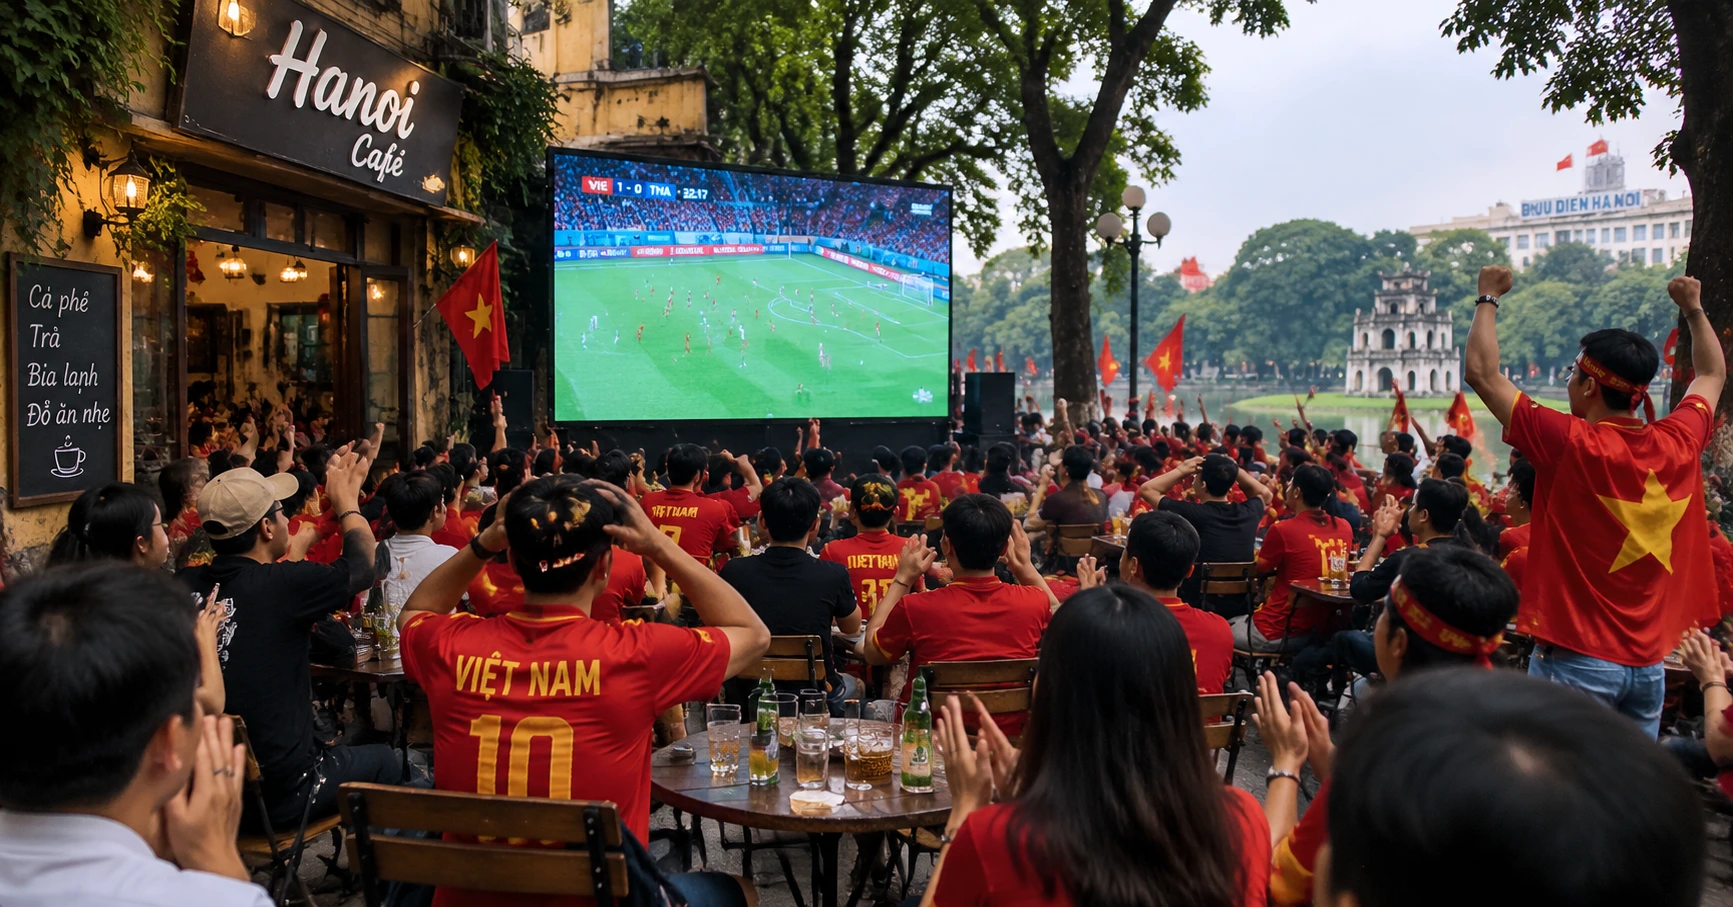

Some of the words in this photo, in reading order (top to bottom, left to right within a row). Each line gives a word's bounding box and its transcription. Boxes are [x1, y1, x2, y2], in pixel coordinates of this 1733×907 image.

[266, 19, 420, 140] Hanoi
[588, 180, 608, 192] VIE
[617, 182, 623, 192] 1
[634, 183, 643, 194] 0
[1555, 196, 1588, 214] DIEN
[27, 362, 57, 387] Bia
[56, 402, 78, 425] ăn
[456, 651, 521, 701] VIỆT
[528, 659, 601, 697] NAM
[469, 714, 574, 801] 10
